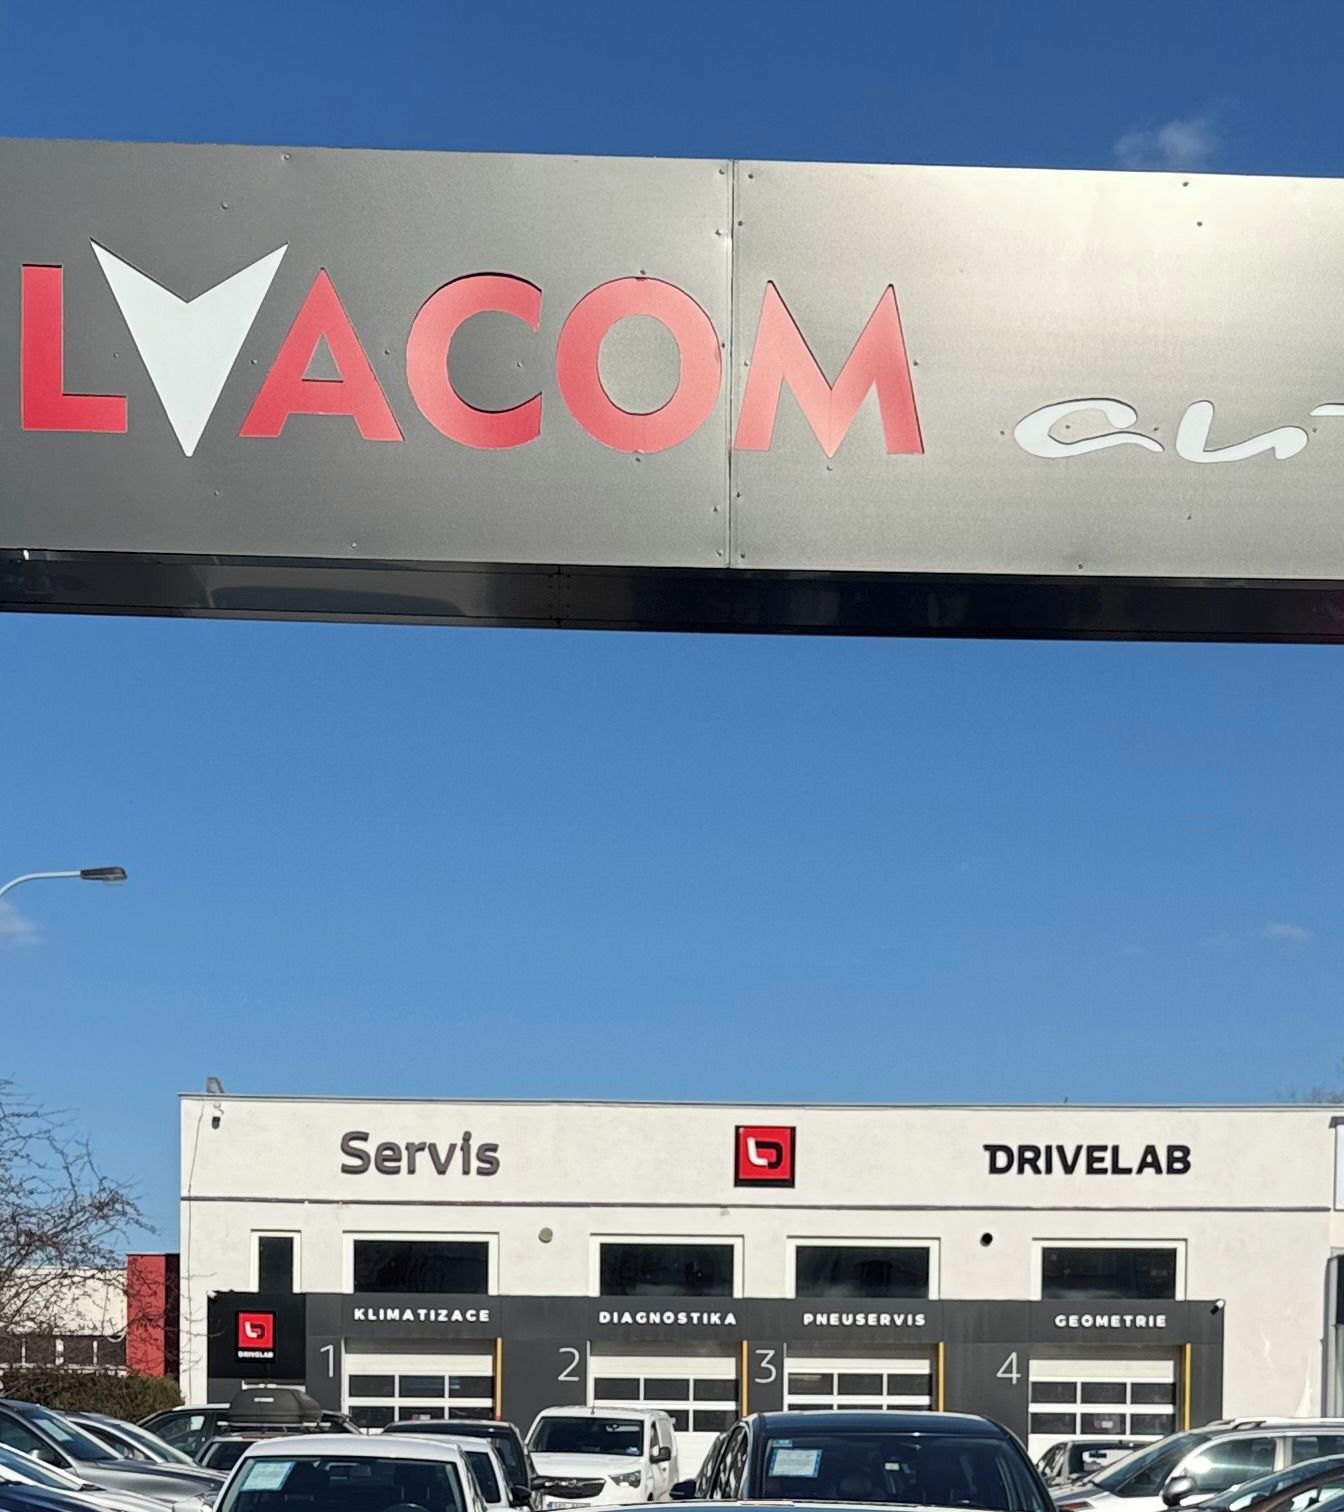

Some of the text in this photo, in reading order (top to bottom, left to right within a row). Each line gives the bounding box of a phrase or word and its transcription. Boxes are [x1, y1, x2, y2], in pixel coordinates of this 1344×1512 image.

[340, 1131, 501, 1176] Servis
[983, 1144, 1192, 1175] DRIVELAB
[354, 1308, 490, 1322] KLIMATIZACE
[599, 1310, 737, 1325] DIAGNOSTIKA
[803, 1312, 926, 1326] PNEUSERVIS
[1055, 1314, 1167, 1328] GEOMETRIE
[320, 1344, 334, 1378] 1
[557, 1347, 581, 1382] 2
[755, 1350, 777, 1384] 3
[996, 1352, 1022, 1385] 4
